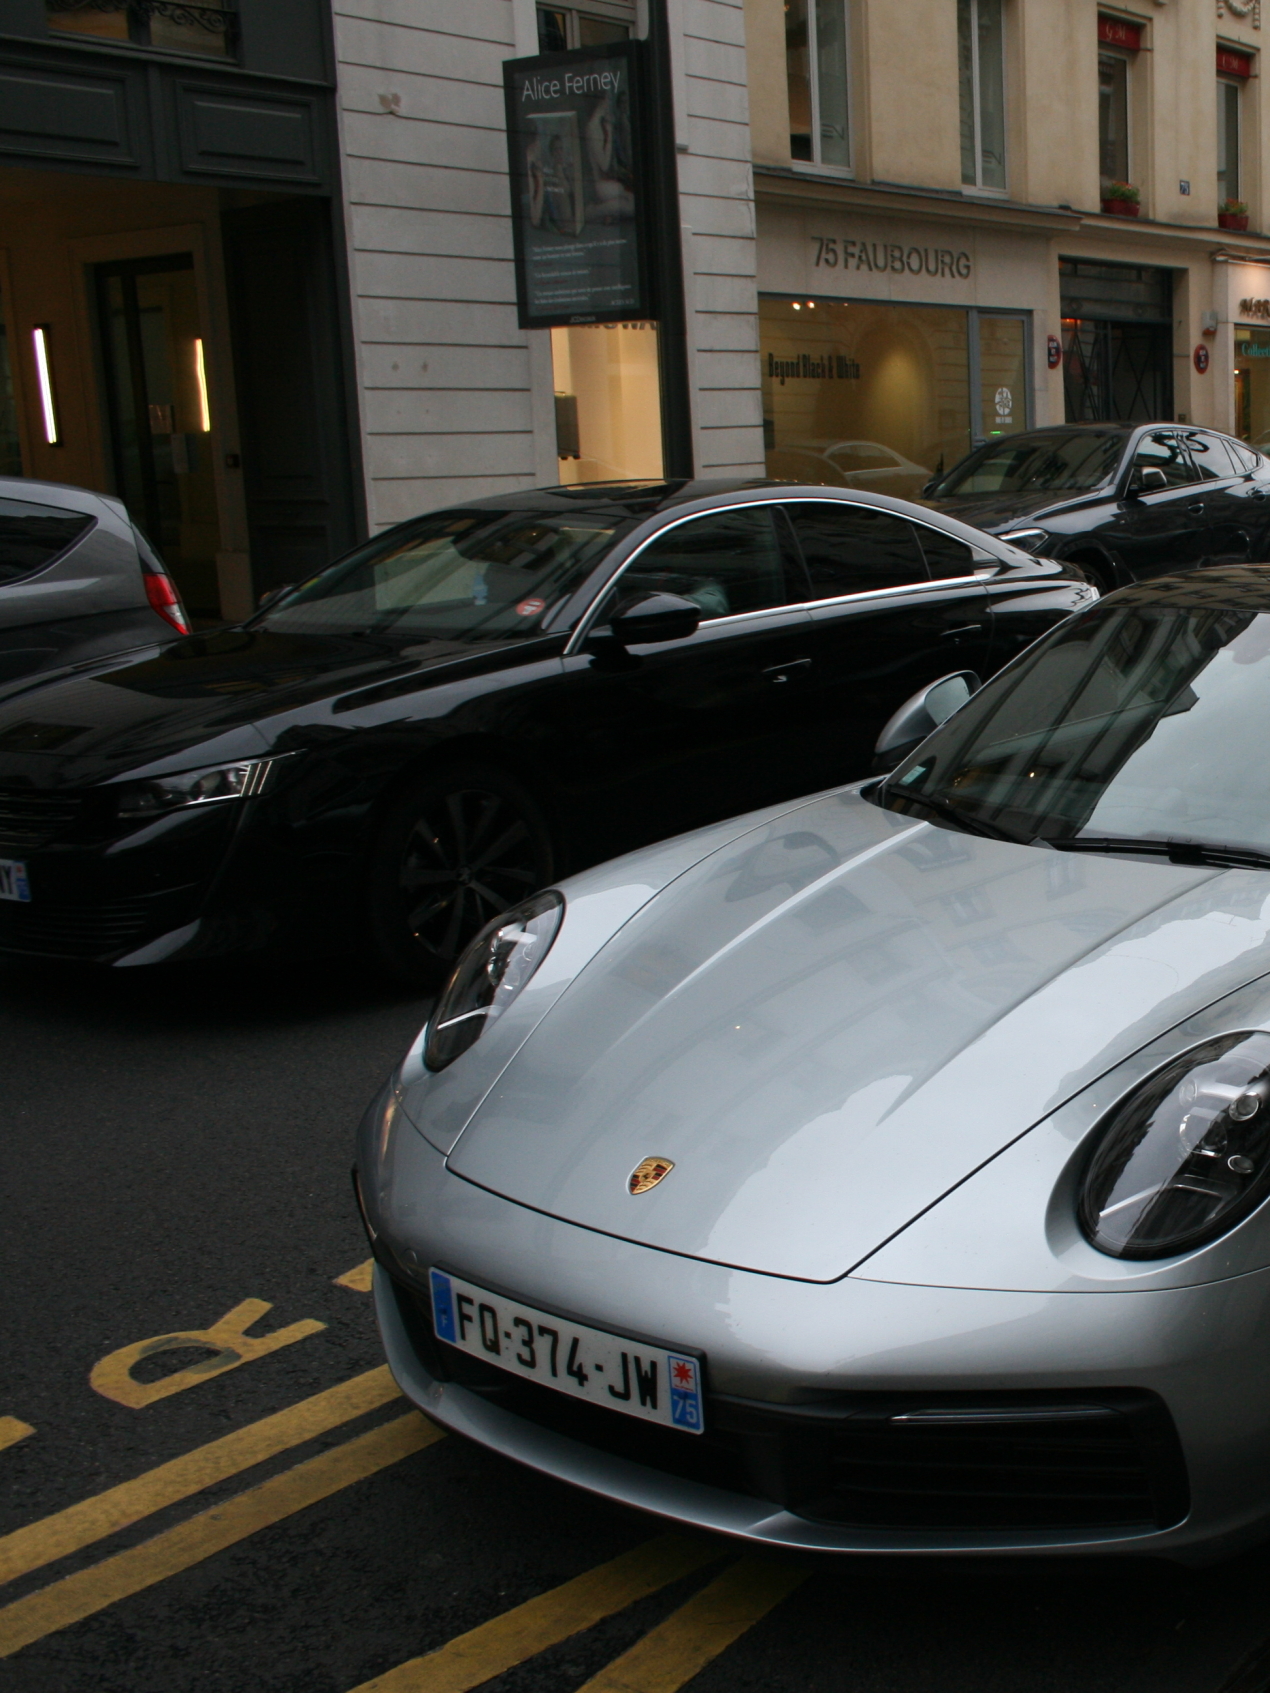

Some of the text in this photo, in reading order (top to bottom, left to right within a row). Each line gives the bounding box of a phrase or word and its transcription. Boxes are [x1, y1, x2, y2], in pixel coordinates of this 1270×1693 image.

[522, 71, 620, 102] Alice Ferney
[811, 236, 971, 280] 75 FAUBOURG
[768, 353, 860, 386] Beyond Black & White
[456, 1292, 658, 1410] FQ-374-JW
[673, 1394, 698, 1424] 75
